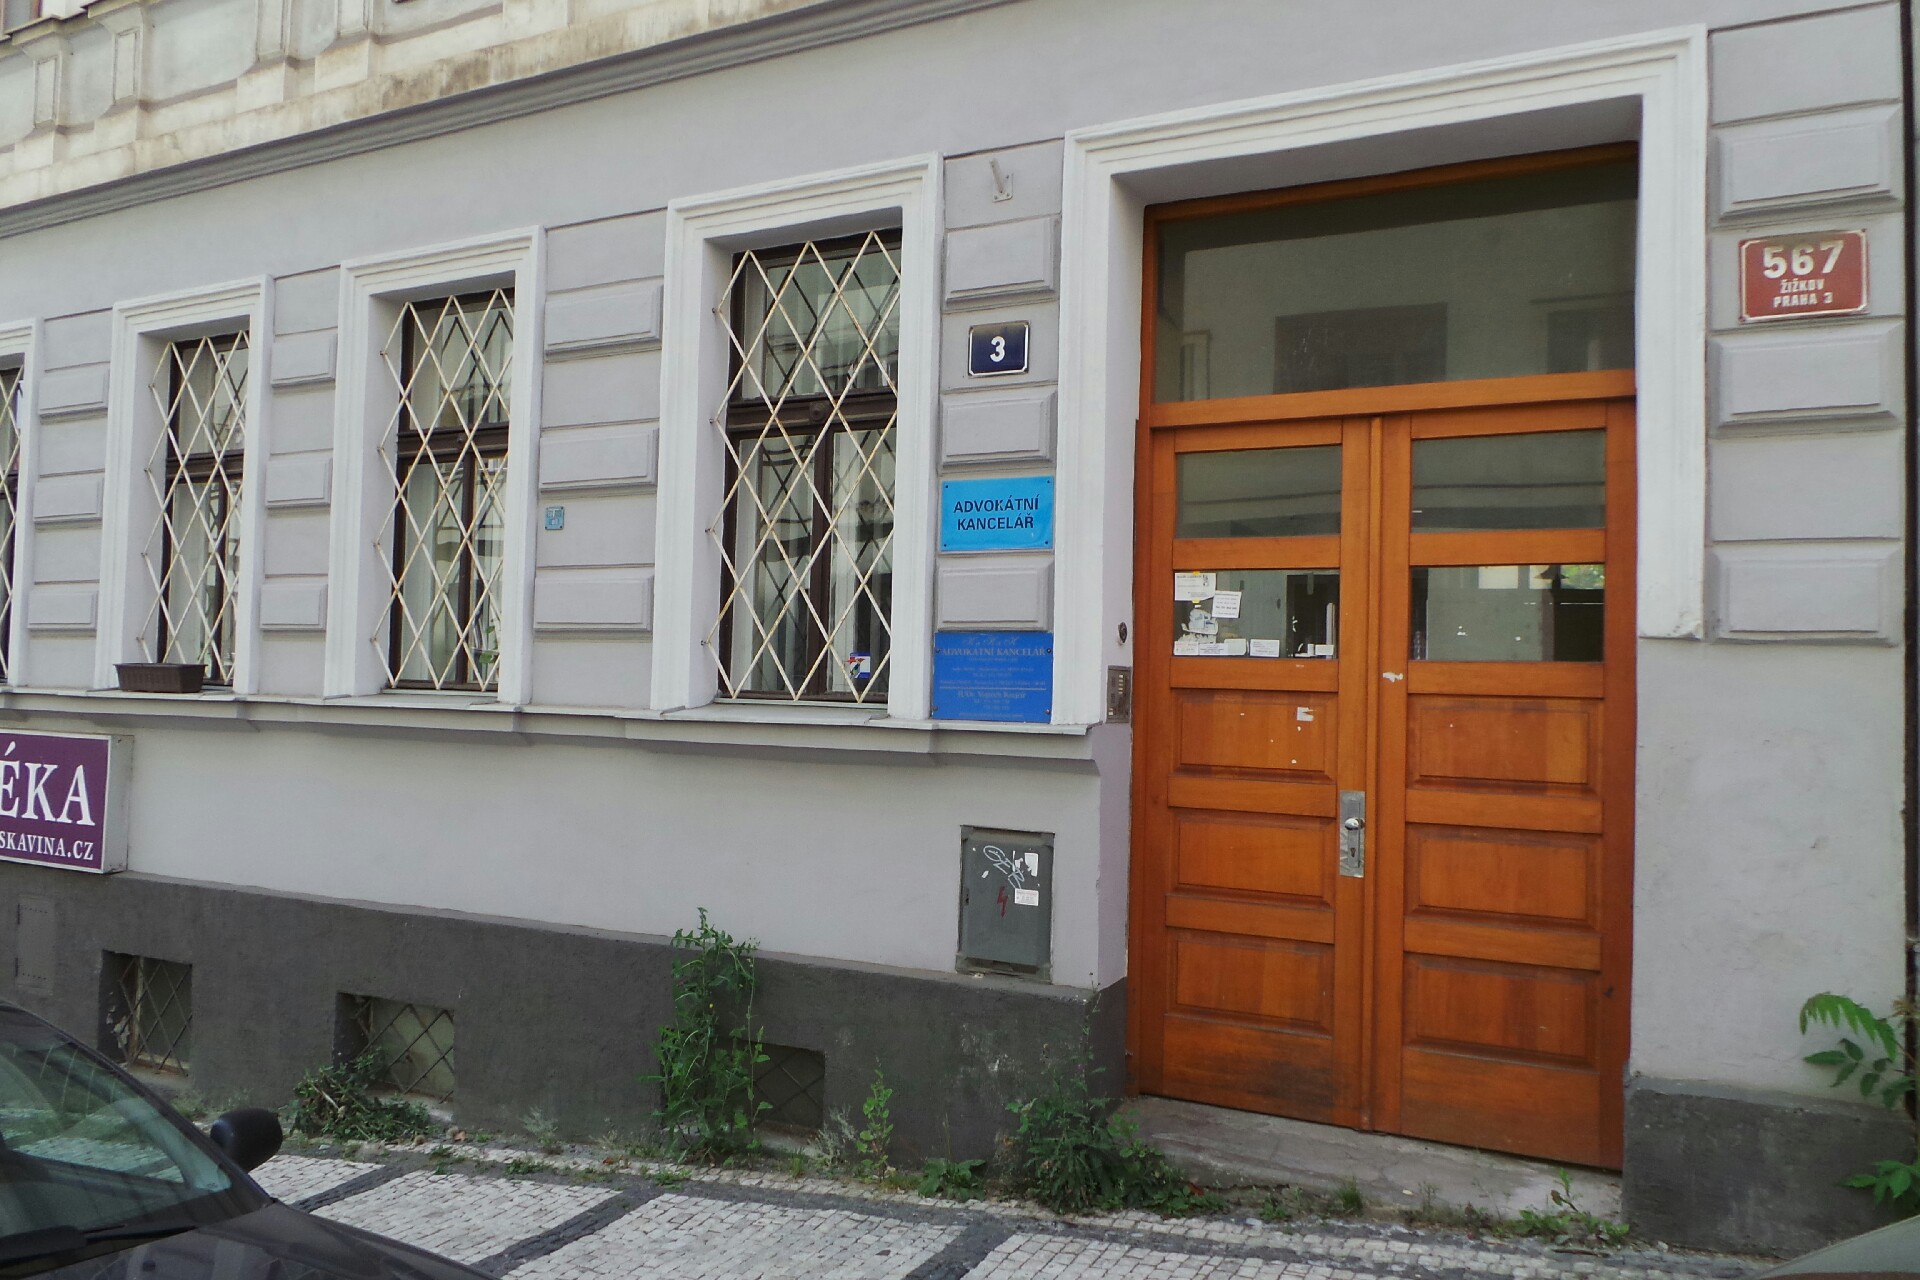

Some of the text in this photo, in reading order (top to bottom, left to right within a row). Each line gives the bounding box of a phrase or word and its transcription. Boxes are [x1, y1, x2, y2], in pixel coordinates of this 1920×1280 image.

[1763, 240, 1845, 279] 567
[1780, 278, 1825, 293] ŽIŽKOV
[1774, 292, 1833, 308] PRAHA 3
[990, 336, 1005, 362] 3
[953, 494, 1039, 513] ADVOKÁTNÍ
[957, 513, 1034, 531] KANCELÁŘ
